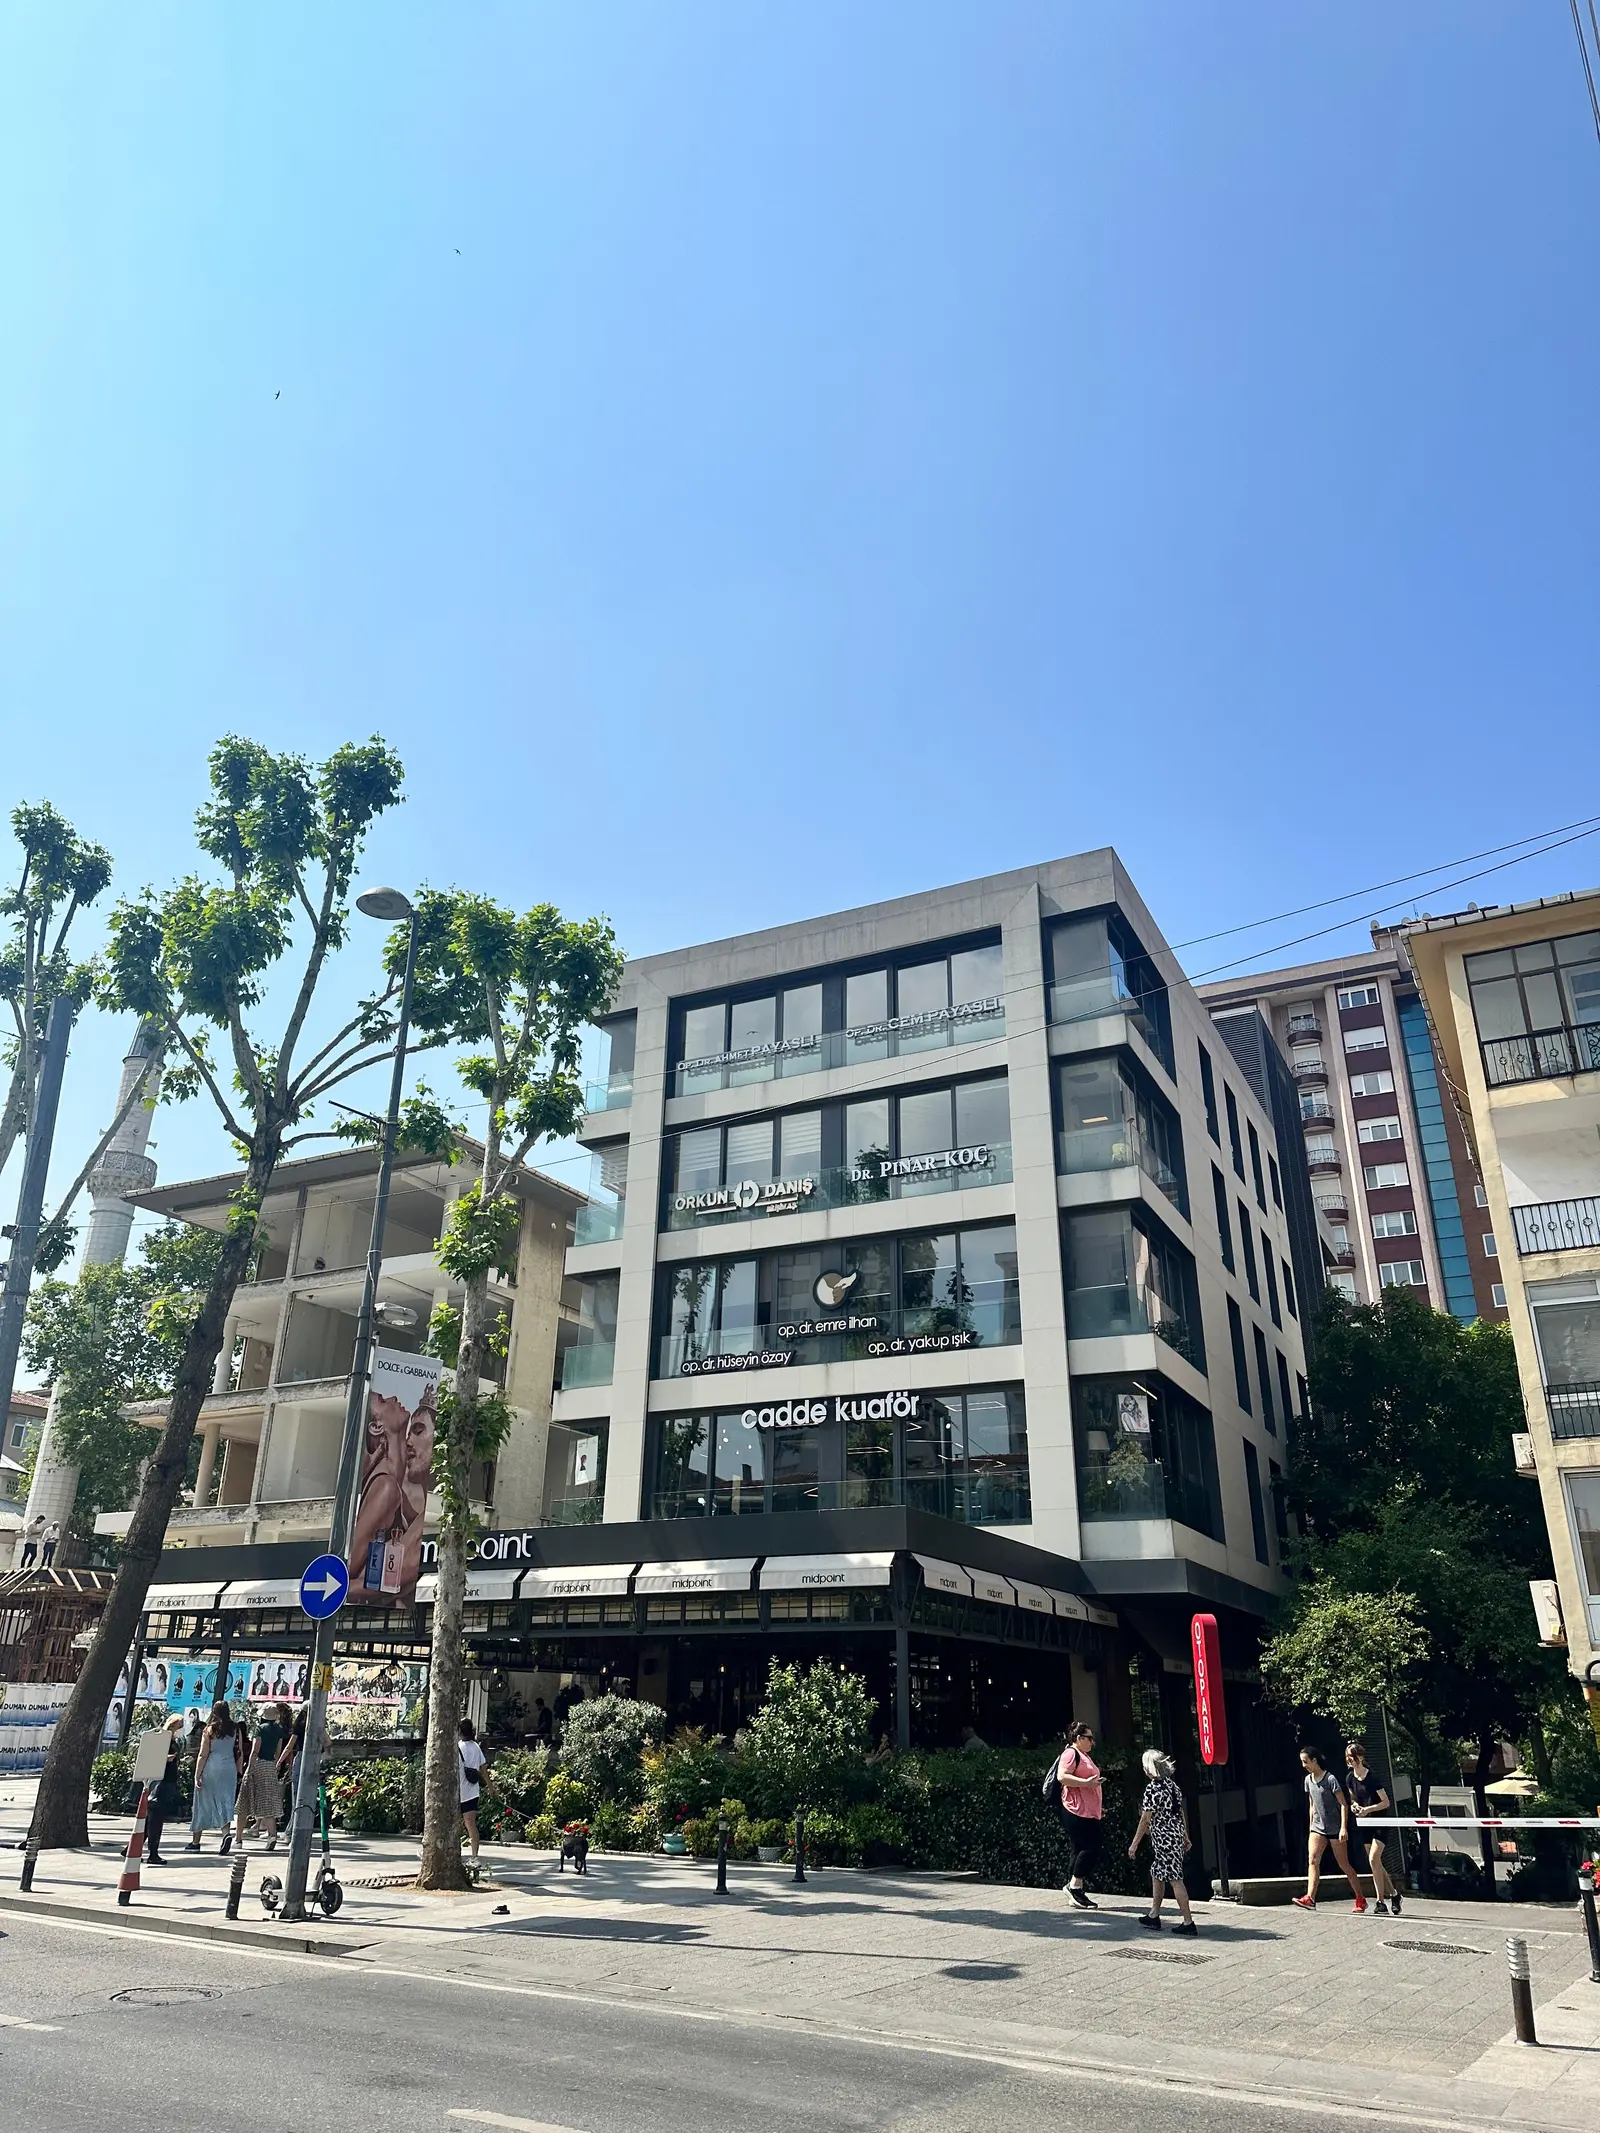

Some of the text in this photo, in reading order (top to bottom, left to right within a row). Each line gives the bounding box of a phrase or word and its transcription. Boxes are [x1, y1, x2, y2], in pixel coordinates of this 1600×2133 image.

[888, 1016, 924, 1029] CEM
[924, 997, 1000, 1022] PAYASLI
[716, 1048, 751, 1063] AHMET
[751, 1034, 816, 1056] PAYASLI
[851, 1146, 989, 1182] DR. PINAR KOÇ
[675, 1178, 813, 1211] ORKUN DANIŞ
[778, 1316, 877, 1338] op. dr. emre ilhan
[868, 1331, 971, 1355] op. dr. yakup ışık
[377, 1360, 400, 1373] DOLCE
[403, 1365, 438, 1380] GABBANA
[682, 1351, 792, 1374] op. dr. hüseyin özay
[741, 1391, 920, 1429] cadde kuaför
[553, 1583, 592, 1594] midpoint
[671, 1578, 713, 1589] midpoint
[801, 1573, 846, 1585] midpoint
[156, 1599, 187, 1608] midpoint
[246, 1596, 278, 1605] midpoint
[1194, 1621, 1211, 1754] OTOPARK
